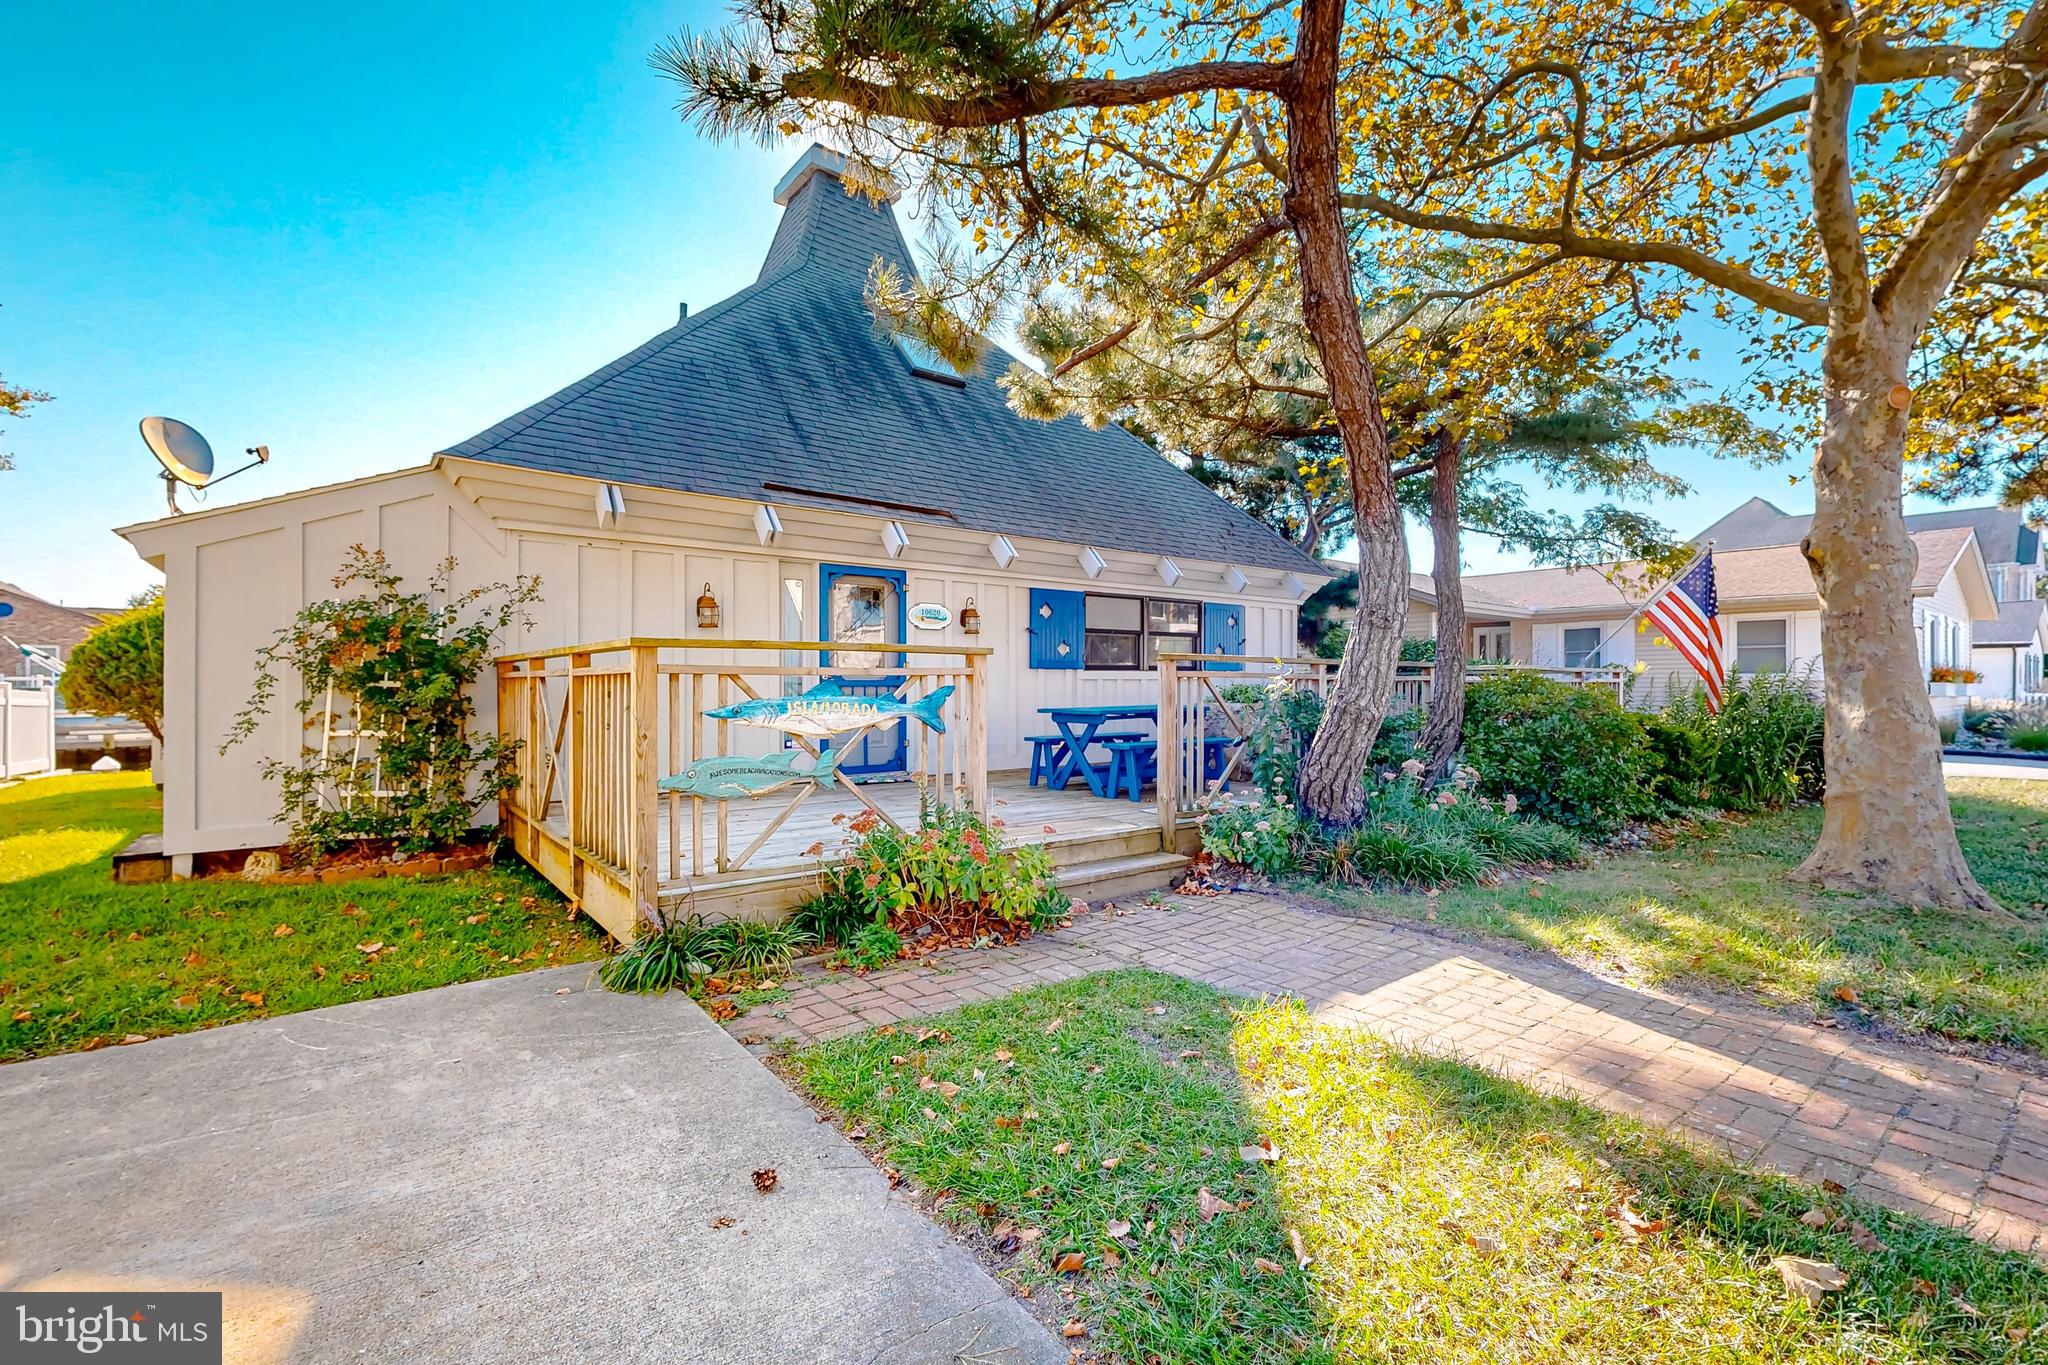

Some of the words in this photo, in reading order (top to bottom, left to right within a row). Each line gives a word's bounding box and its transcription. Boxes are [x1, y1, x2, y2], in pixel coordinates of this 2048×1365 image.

[921, 608, 941, 616] 10620
[787, 701, 879, 717] ISLAMORADA
[709, 767, 802, 779] AWESOMEBEACHVACATIONS.COM
